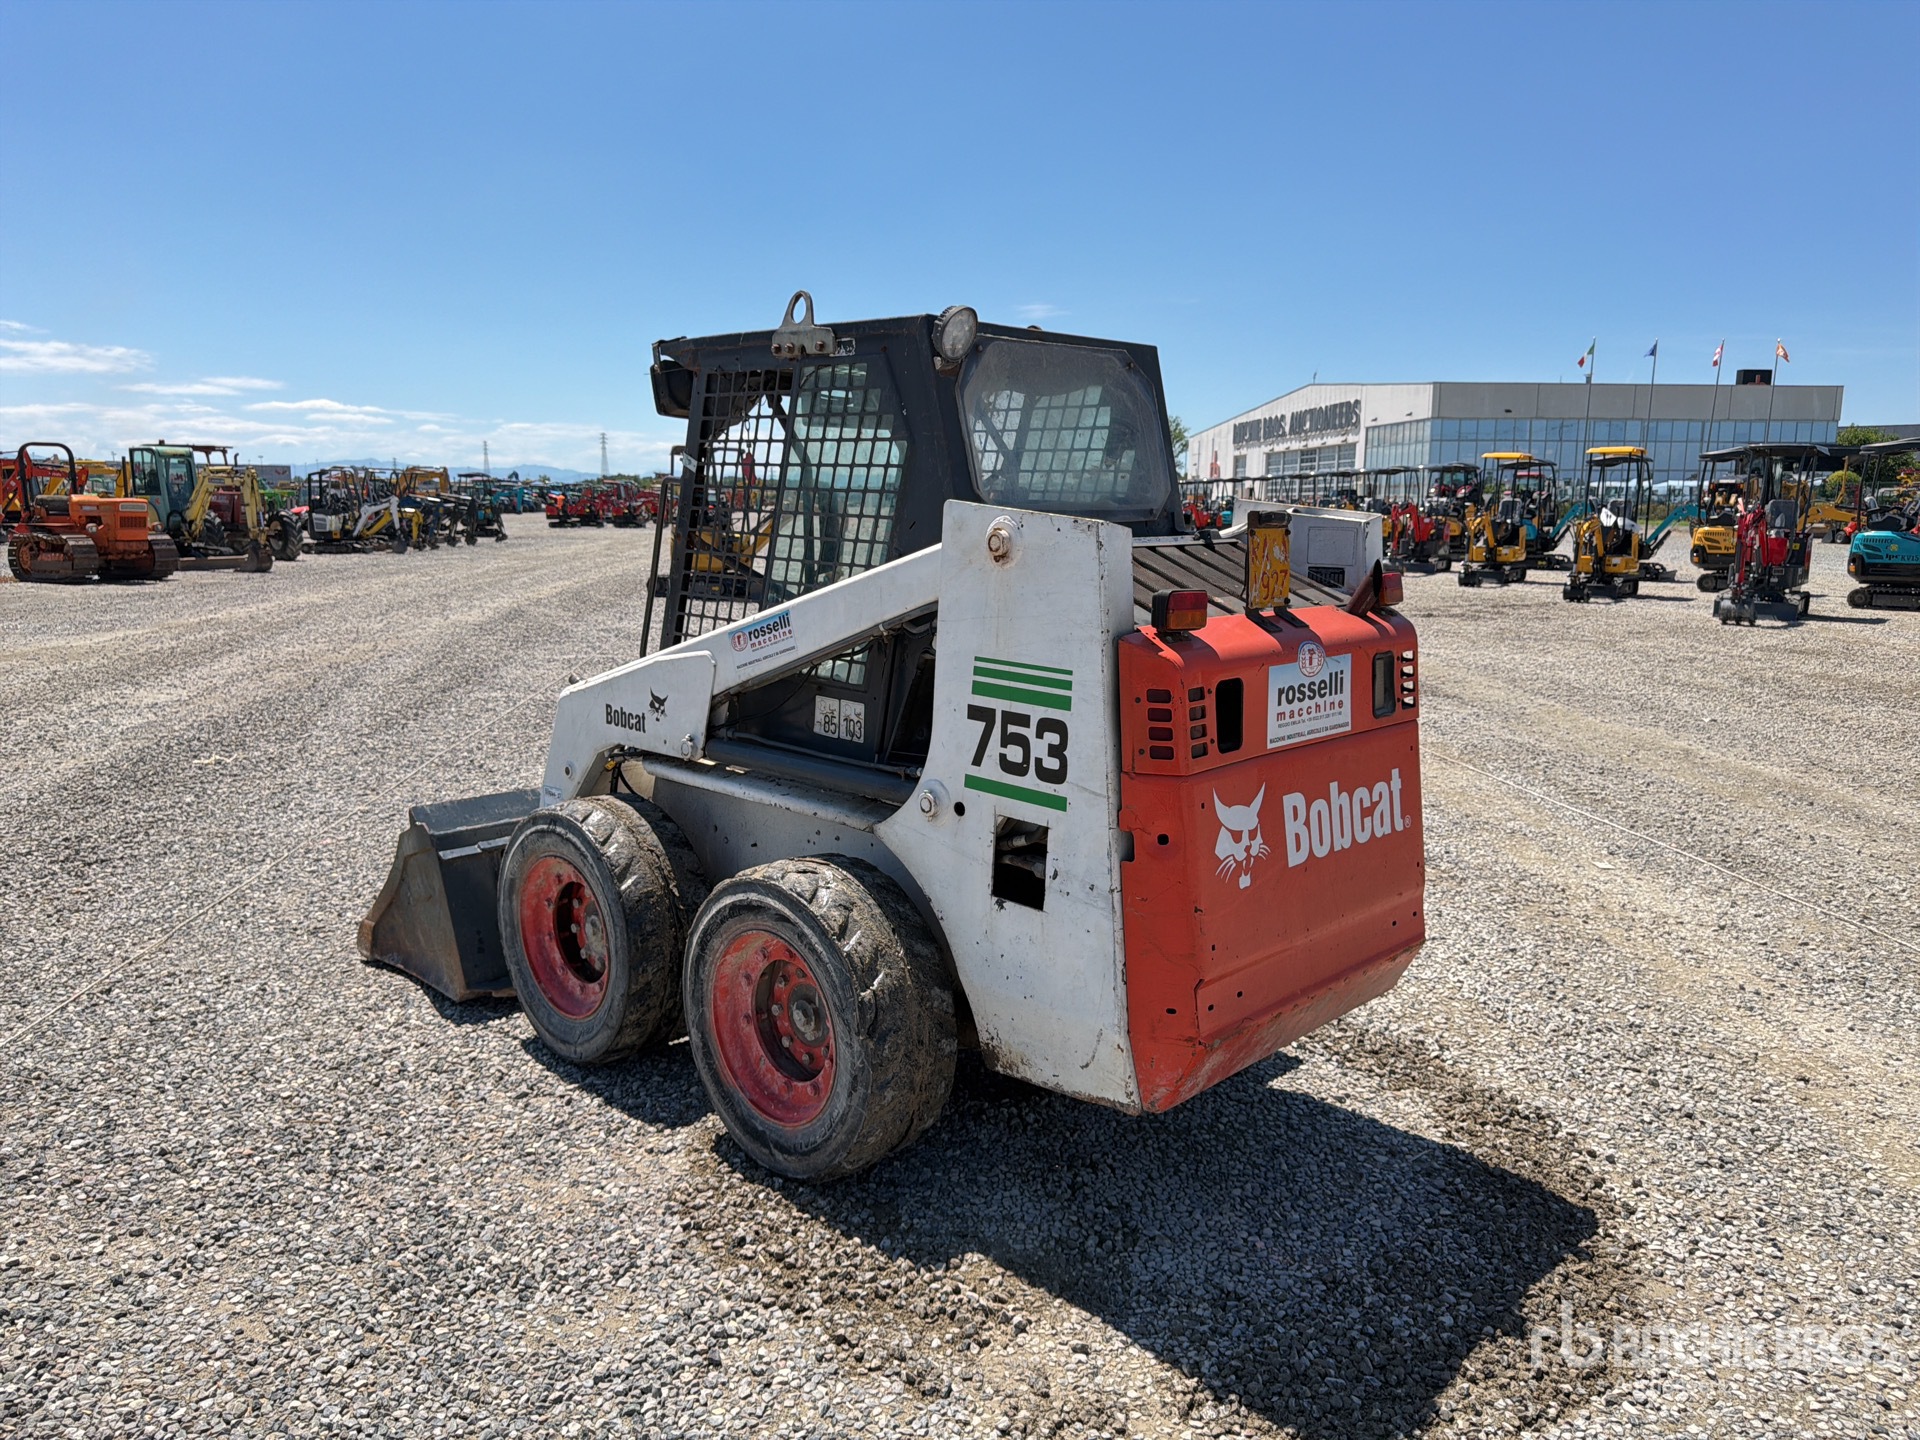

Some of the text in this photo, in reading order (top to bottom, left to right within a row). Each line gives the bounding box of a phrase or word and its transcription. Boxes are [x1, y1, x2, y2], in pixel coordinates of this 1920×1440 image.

[1289, 399, 1362, 435] AUCTIONEERS
[748, 612, 791, 642] rosselli
[750, 629, 793, 649] macchine
[1277, 669, 1344, 707] rosselli
[605, 703, 646, 734] Bobcat
[823, 714, 837, 735] 85
[1276, 699, 1344, 722] macchine
[843, 717, 862, 740] 103
[967, 704, 1068, 785] 753
[1282, 767, 1404, 869] Bobcat
